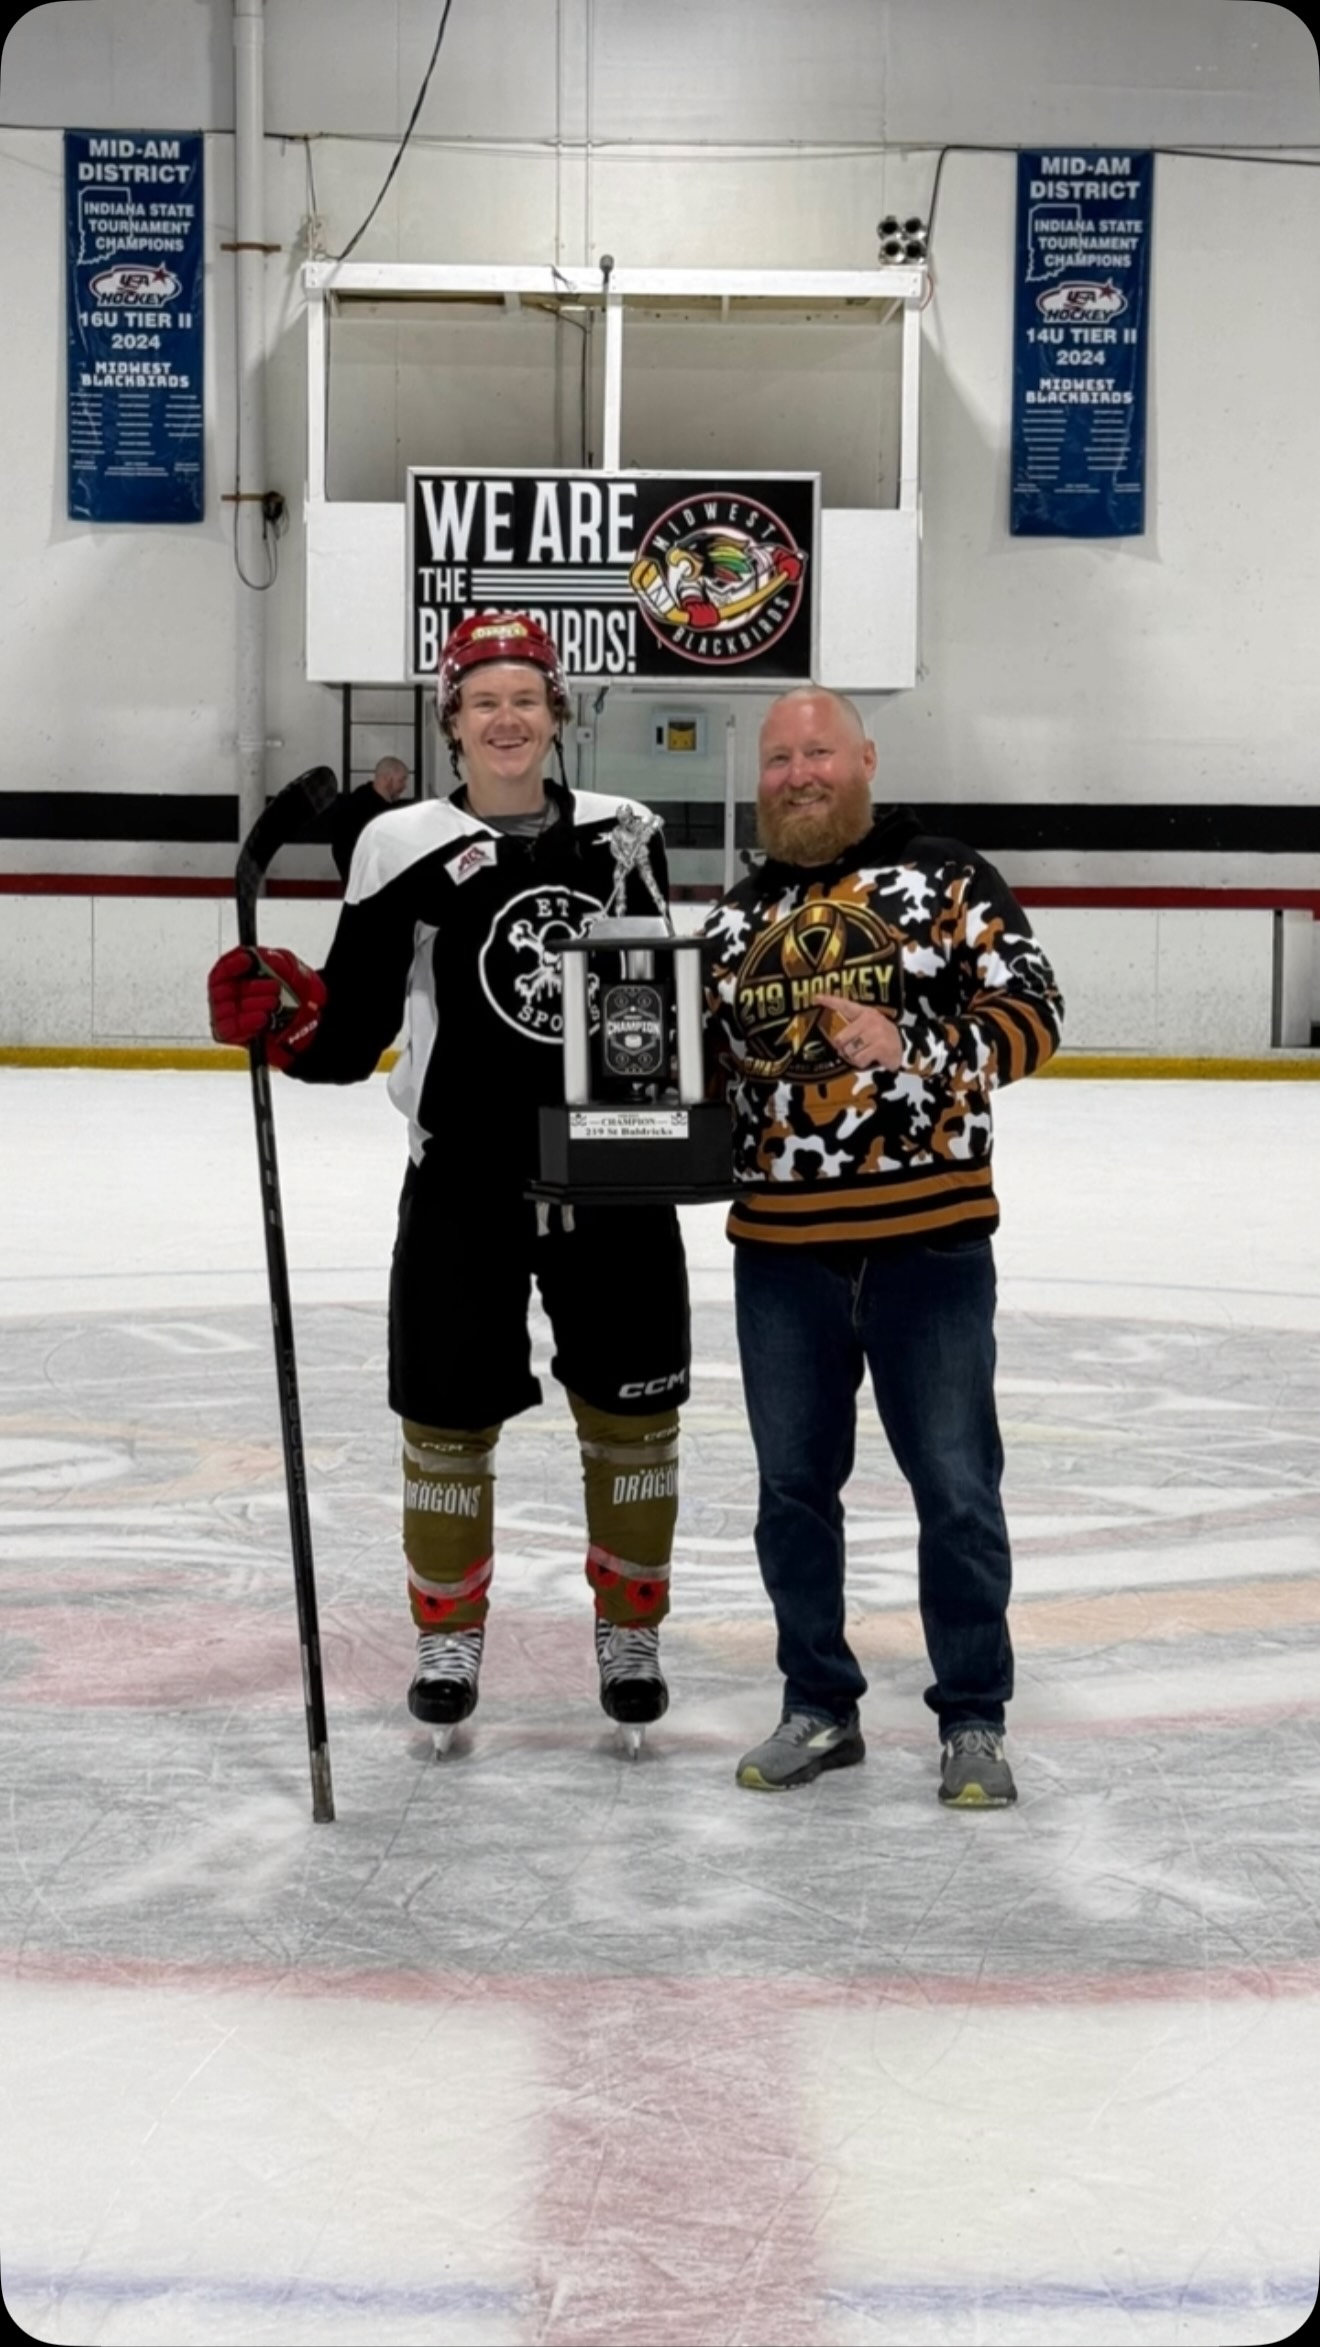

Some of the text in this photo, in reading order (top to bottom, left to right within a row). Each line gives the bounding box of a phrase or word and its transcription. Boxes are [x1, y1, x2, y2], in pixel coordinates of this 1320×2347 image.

[89, 139, 180, 159] MID-AM
[79, 162, 191, 183] DISTRICT
[1041, 157, 1131, 175] MID-AM
[1030, 181, 1140, 199] DISTRICT
[84, 202, 194, 217] INDIANA STATE
[88, 219, 191, 234] TOURNAMENT
[1034, 220, 1143, 233] INDIANA STATE
[95, 237, 184, 252] CHAMPIONS
[1037, 236, 1139, 251] TOURNAMENT
[1044, 254, 1132, 268] CHAMPIONS
[119, 274, 149, 291] USA
[100, 291, 167, 305] HOCKEY
[1066, 290, 1097, 306] USA
[80, 311, 192, 329] 16U TIER II
[1047, 308, 1113, 321] HOCKEY
[111, 333, 161, 349] 2024
[1026, 328, 1137, 344] 14U TIER II
[1056, 350, 1106, 365] 2024
[95, 361, 172, 374] MIDWEST
[81, 373, 190, 388] BLACKBIRDS
[1040, 378, 1116, 391] MIDWEST
[1025, 390, 1134, 405] BLACKBIRDS
[418, 480, 637, 563] WE ARE
[652, 501, 776, 552] MIDWEST
[418, 568, 468, 603] THE
[672, 597, 790, 655] BLACKBIRDS
[419, 607, 637, 673] BIRDS!
[536, 898, 569, 917] ET
[740, 964, 894, 1024] 219 HOCKEY
[517, 1004, 600, 1032] SPOS
[606, 1021, 660, 1035] CHAMPION
[601, 1118, 656, 1127] CHAMPION
[618, 1367, 687, 1398] CCM
